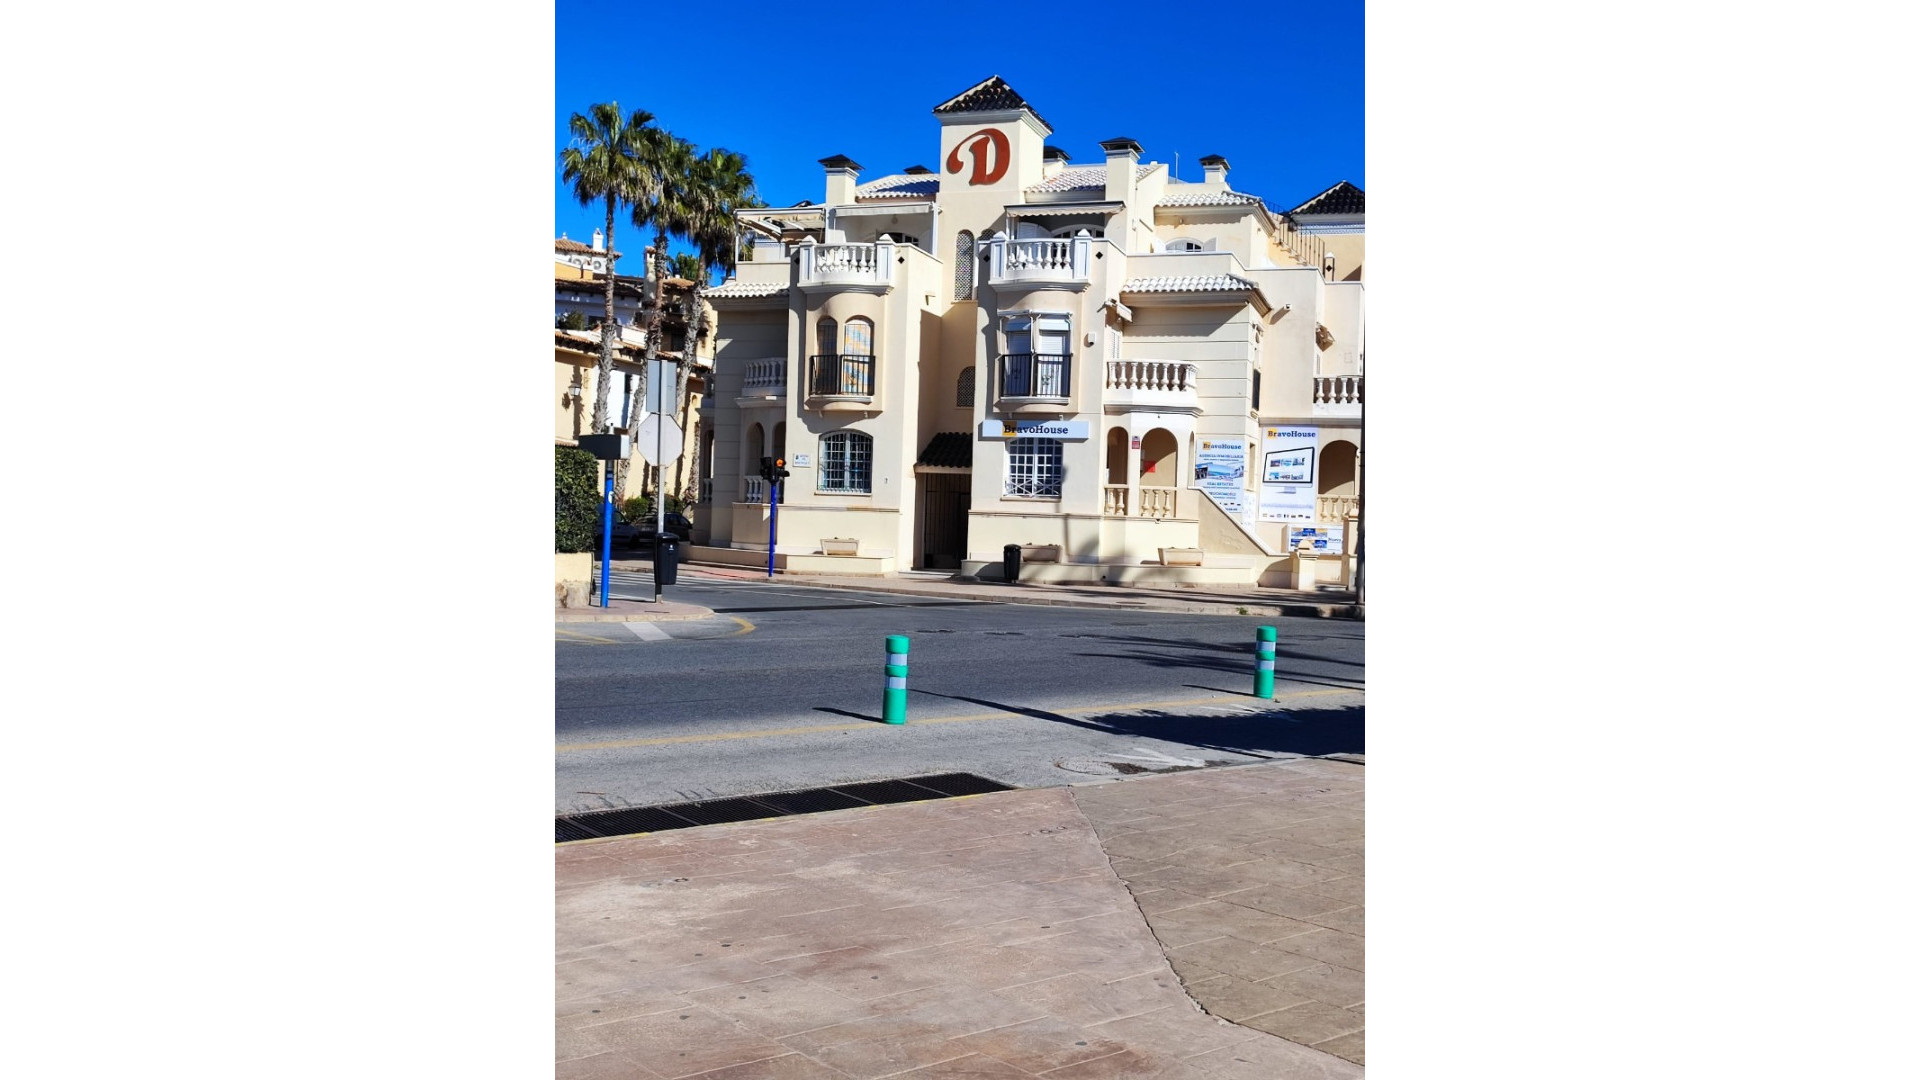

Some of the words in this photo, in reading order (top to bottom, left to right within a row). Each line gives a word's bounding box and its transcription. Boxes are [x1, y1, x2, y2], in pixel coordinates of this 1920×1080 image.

[946, 128, 1010, 186] D
[1004, 425, 1069, 434] BravoHouse
[1268, 430, 1316, 438] BravoHouse
